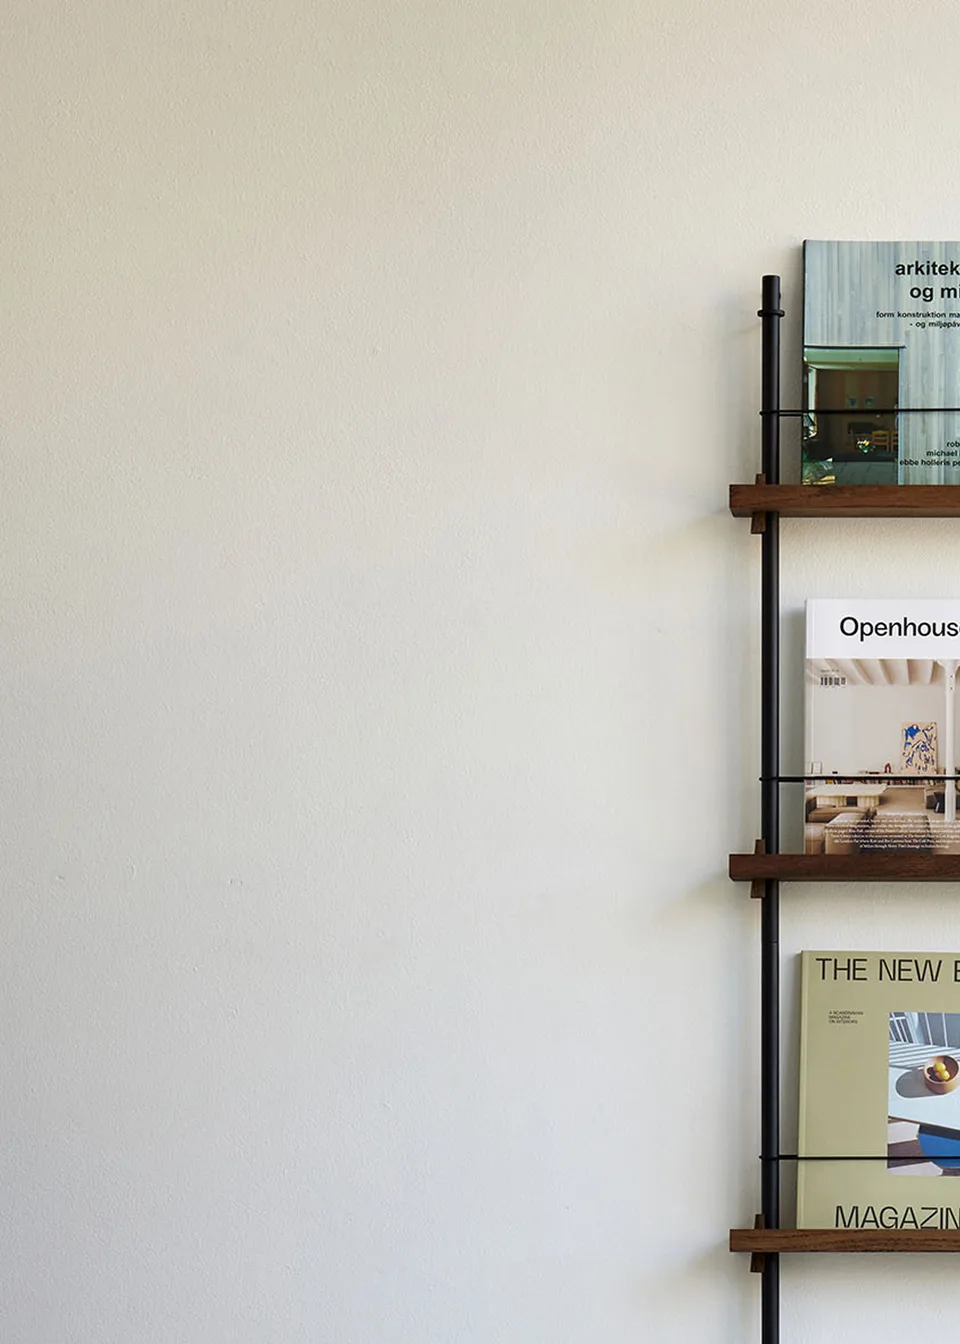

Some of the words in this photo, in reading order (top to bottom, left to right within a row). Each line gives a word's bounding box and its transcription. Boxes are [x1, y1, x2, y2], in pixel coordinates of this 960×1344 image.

[909, 287, 934, 303] og
[876, 311, 895, 319] form
[897, 311, 947, 319] konstruktion
[915, 321, 926, 329] og
[946, 440, 960, 448] rob
[926, 449, 958, 457] michael
[899, 458, 919, 466] ebbe
[815, 957, 868, 981] THE
[878, 958, 943, 982] NEW
